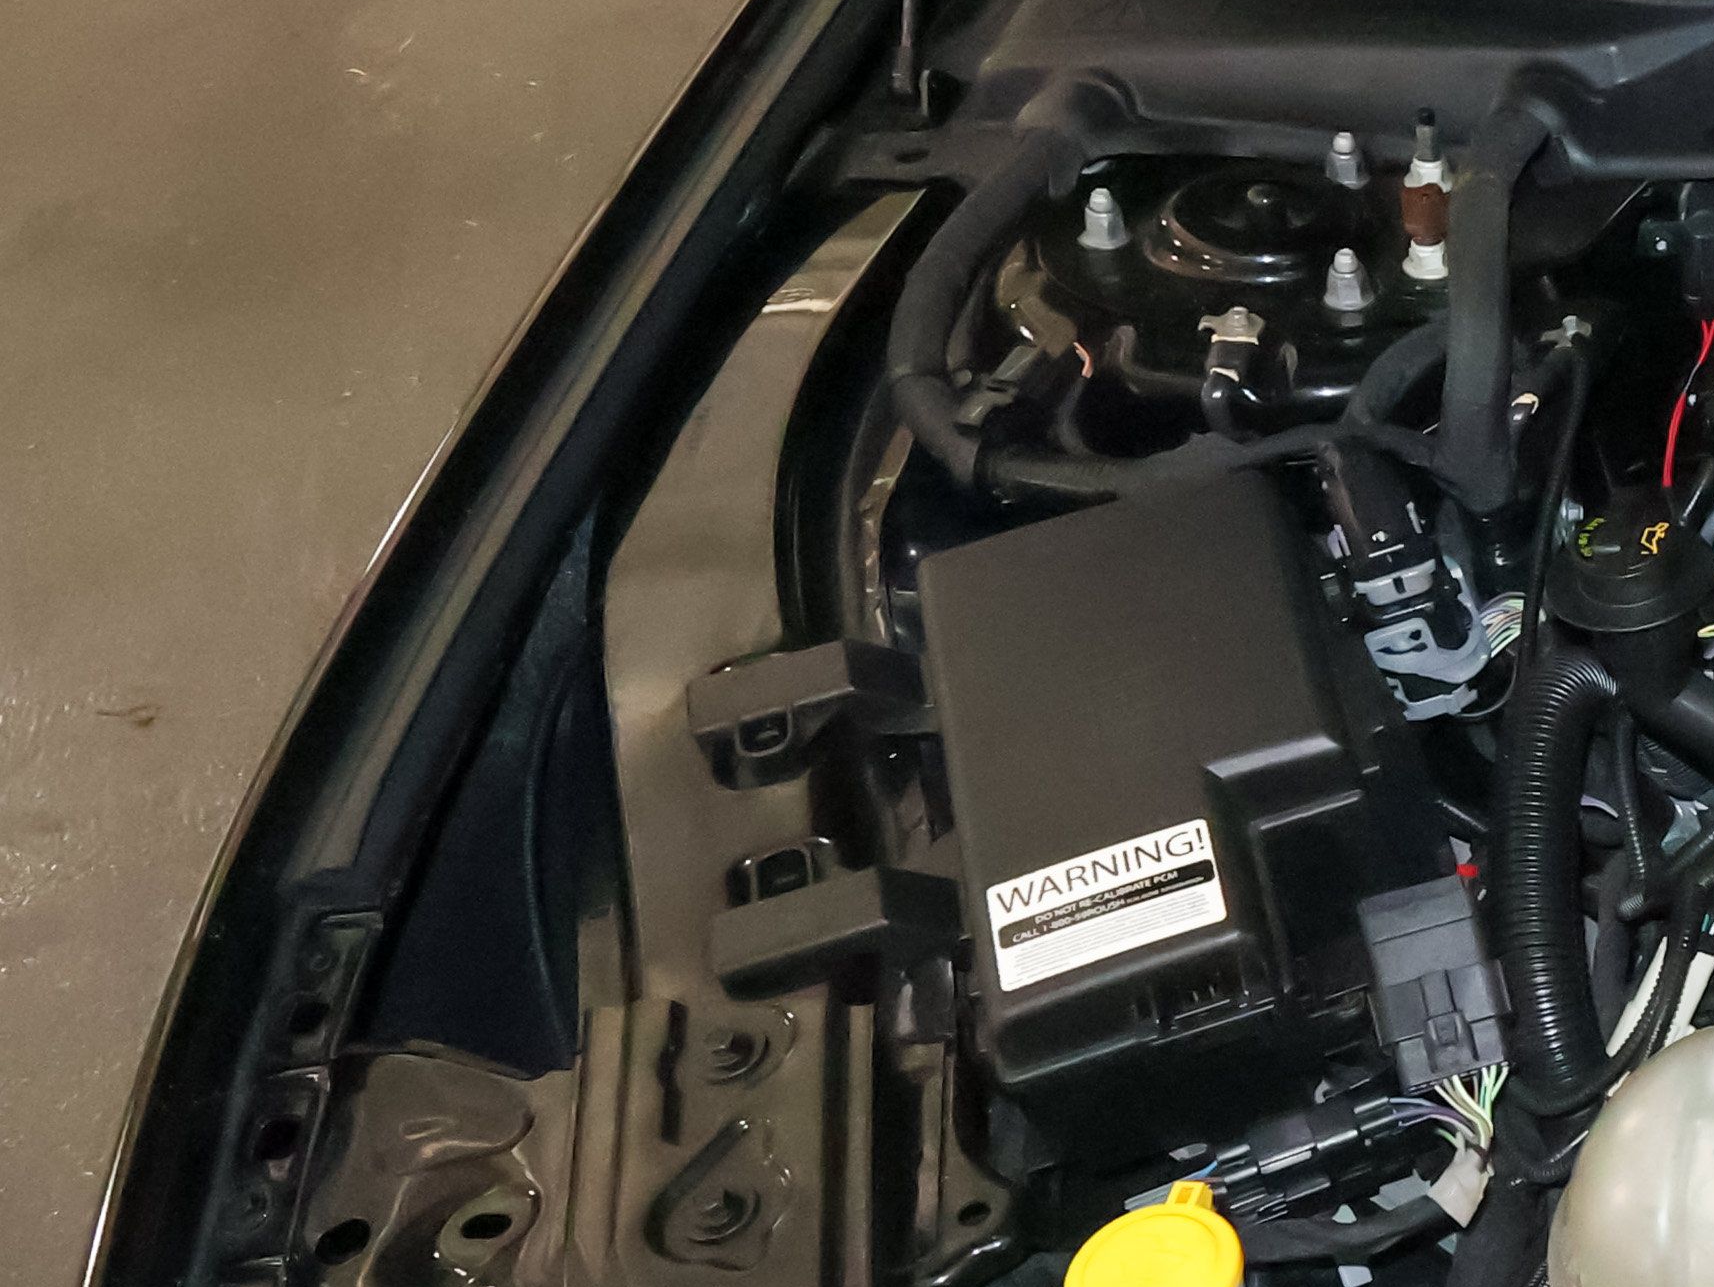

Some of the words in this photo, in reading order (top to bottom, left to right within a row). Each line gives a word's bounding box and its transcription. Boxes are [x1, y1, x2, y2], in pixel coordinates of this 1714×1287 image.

[997, 827, 1205, 913] WARNING!
[1034, 912, 1053, 924] DO
[1012, 928, 1040, 943] CALL
